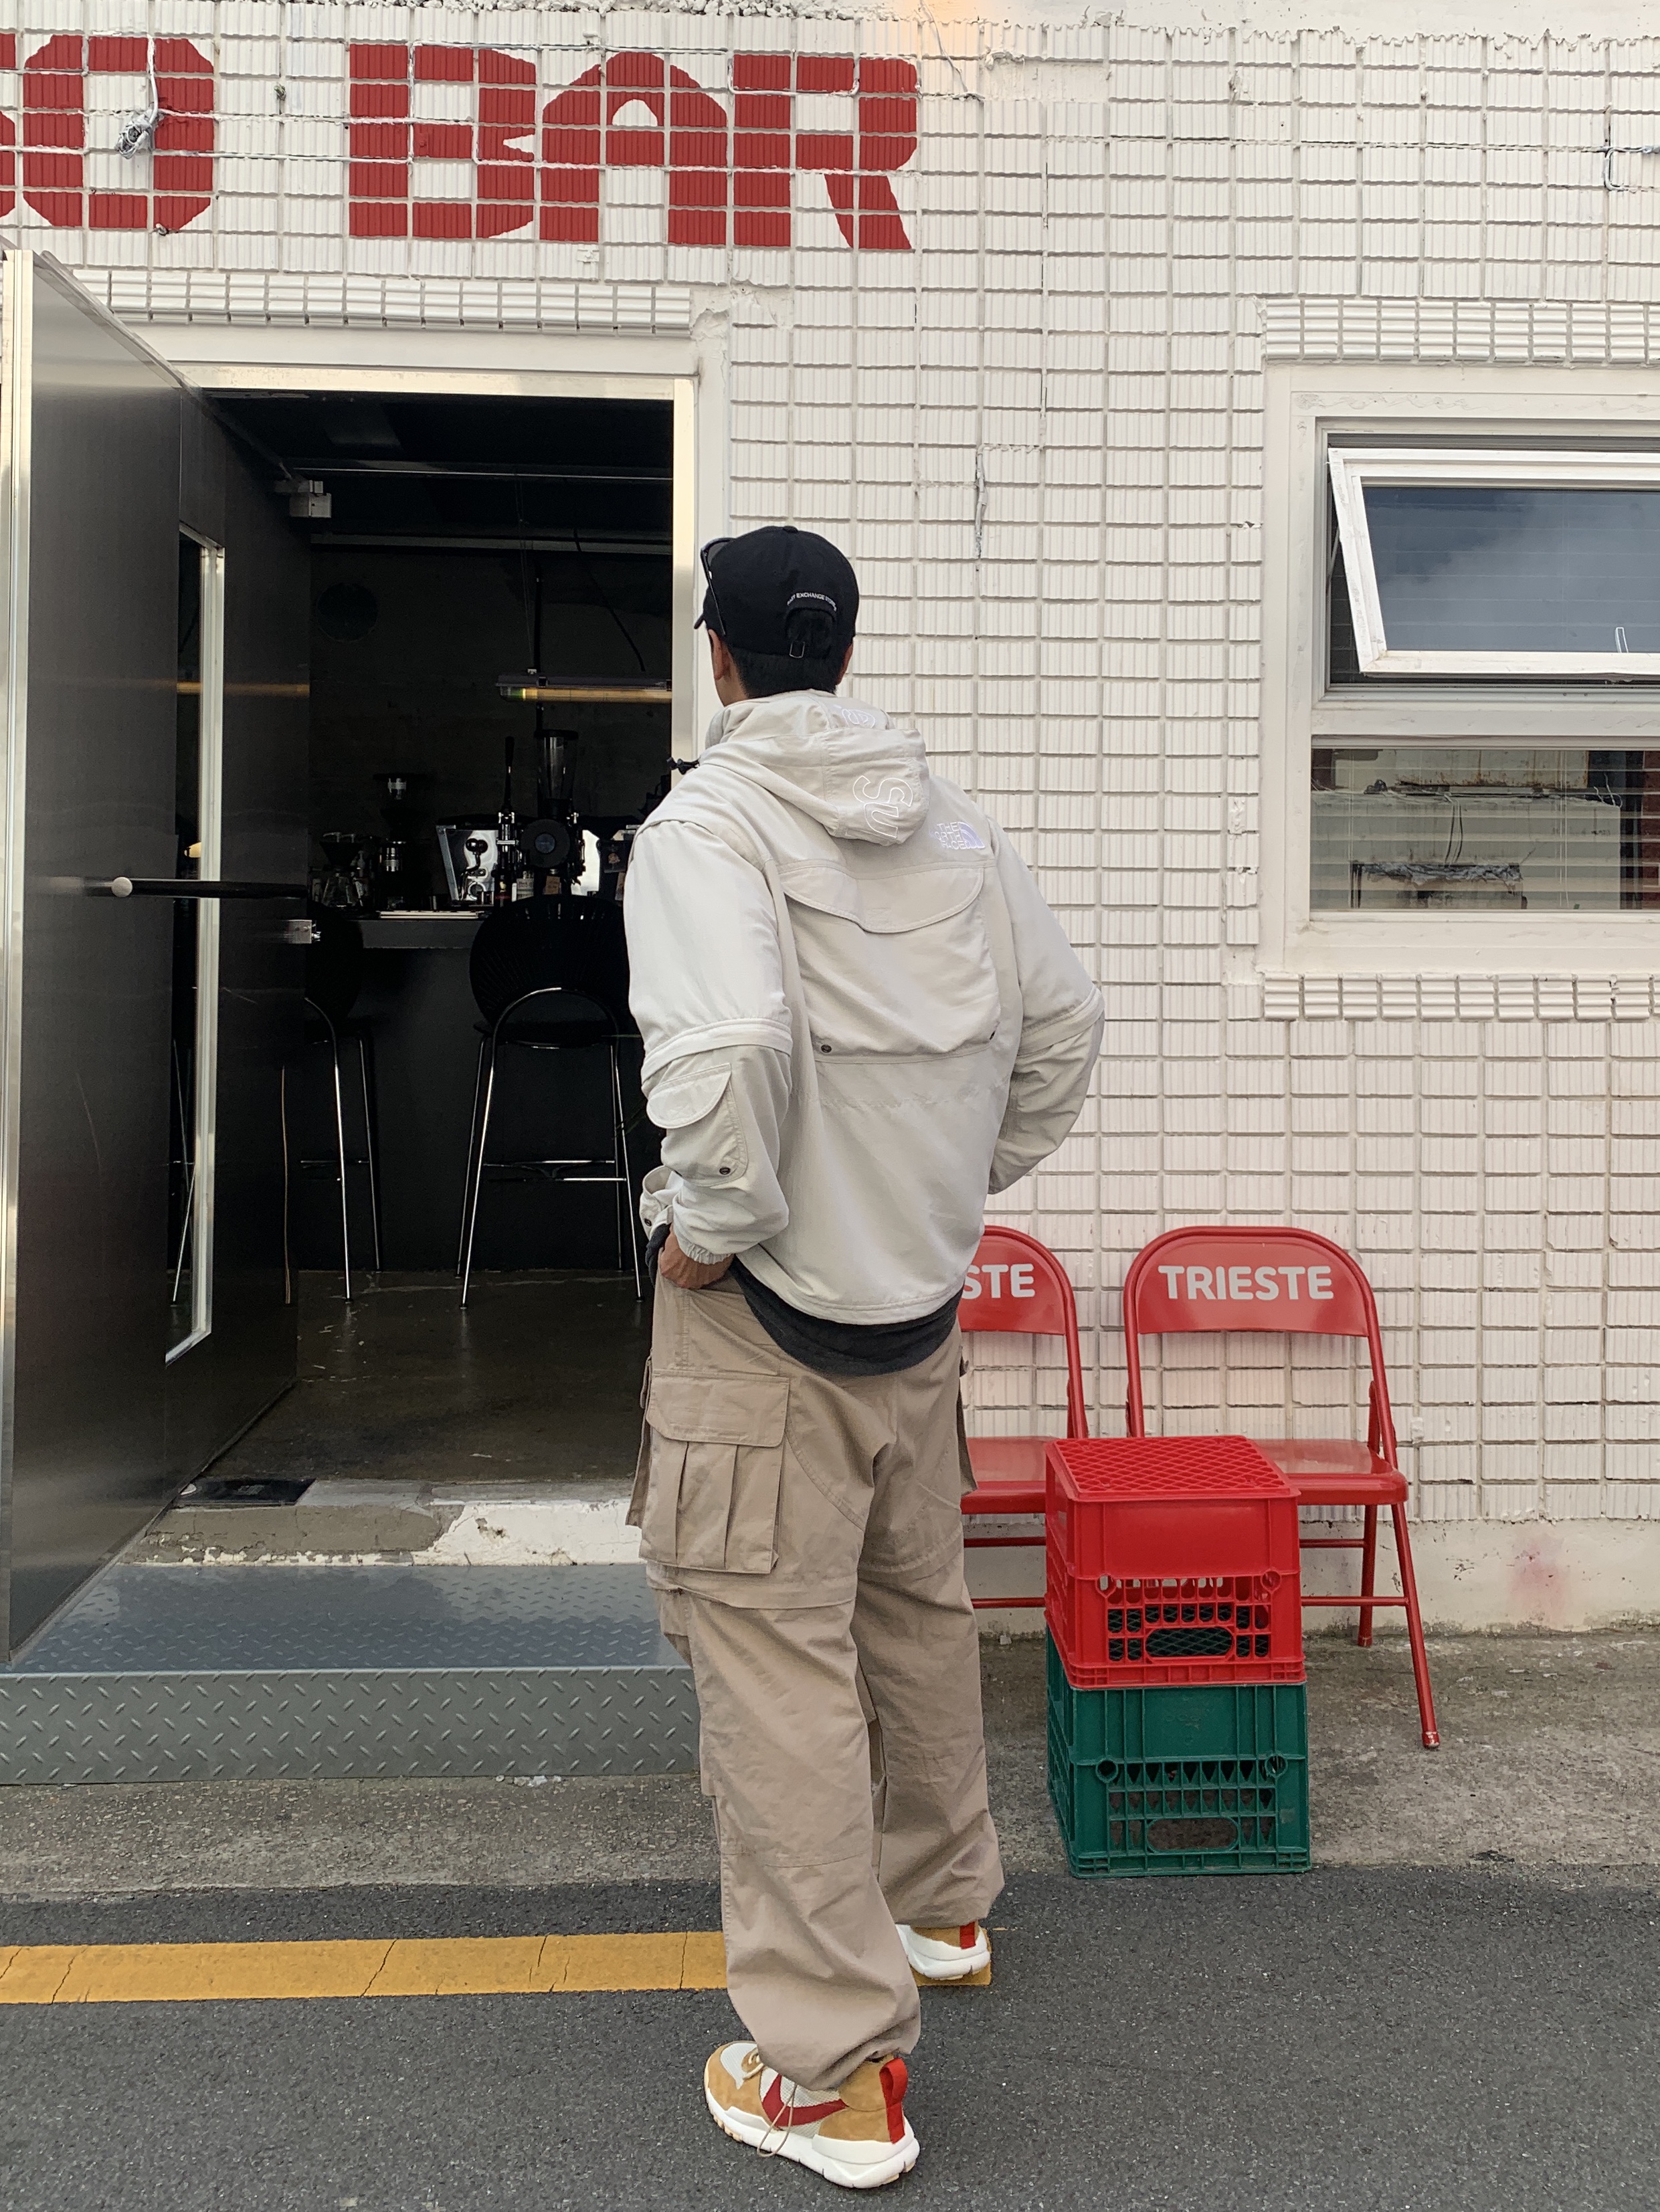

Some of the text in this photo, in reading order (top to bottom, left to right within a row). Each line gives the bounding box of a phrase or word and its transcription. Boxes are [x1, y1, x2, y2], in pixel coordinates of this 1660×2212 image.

[0, 33, 918, 251] O BAR
[796, 592, 826, 601] EXCHANGE
[937, 821, 959, 833] THE
[929, 831, 962, 841] ORTH
[1158, 1265, 1334, 1301] TRIESTE
